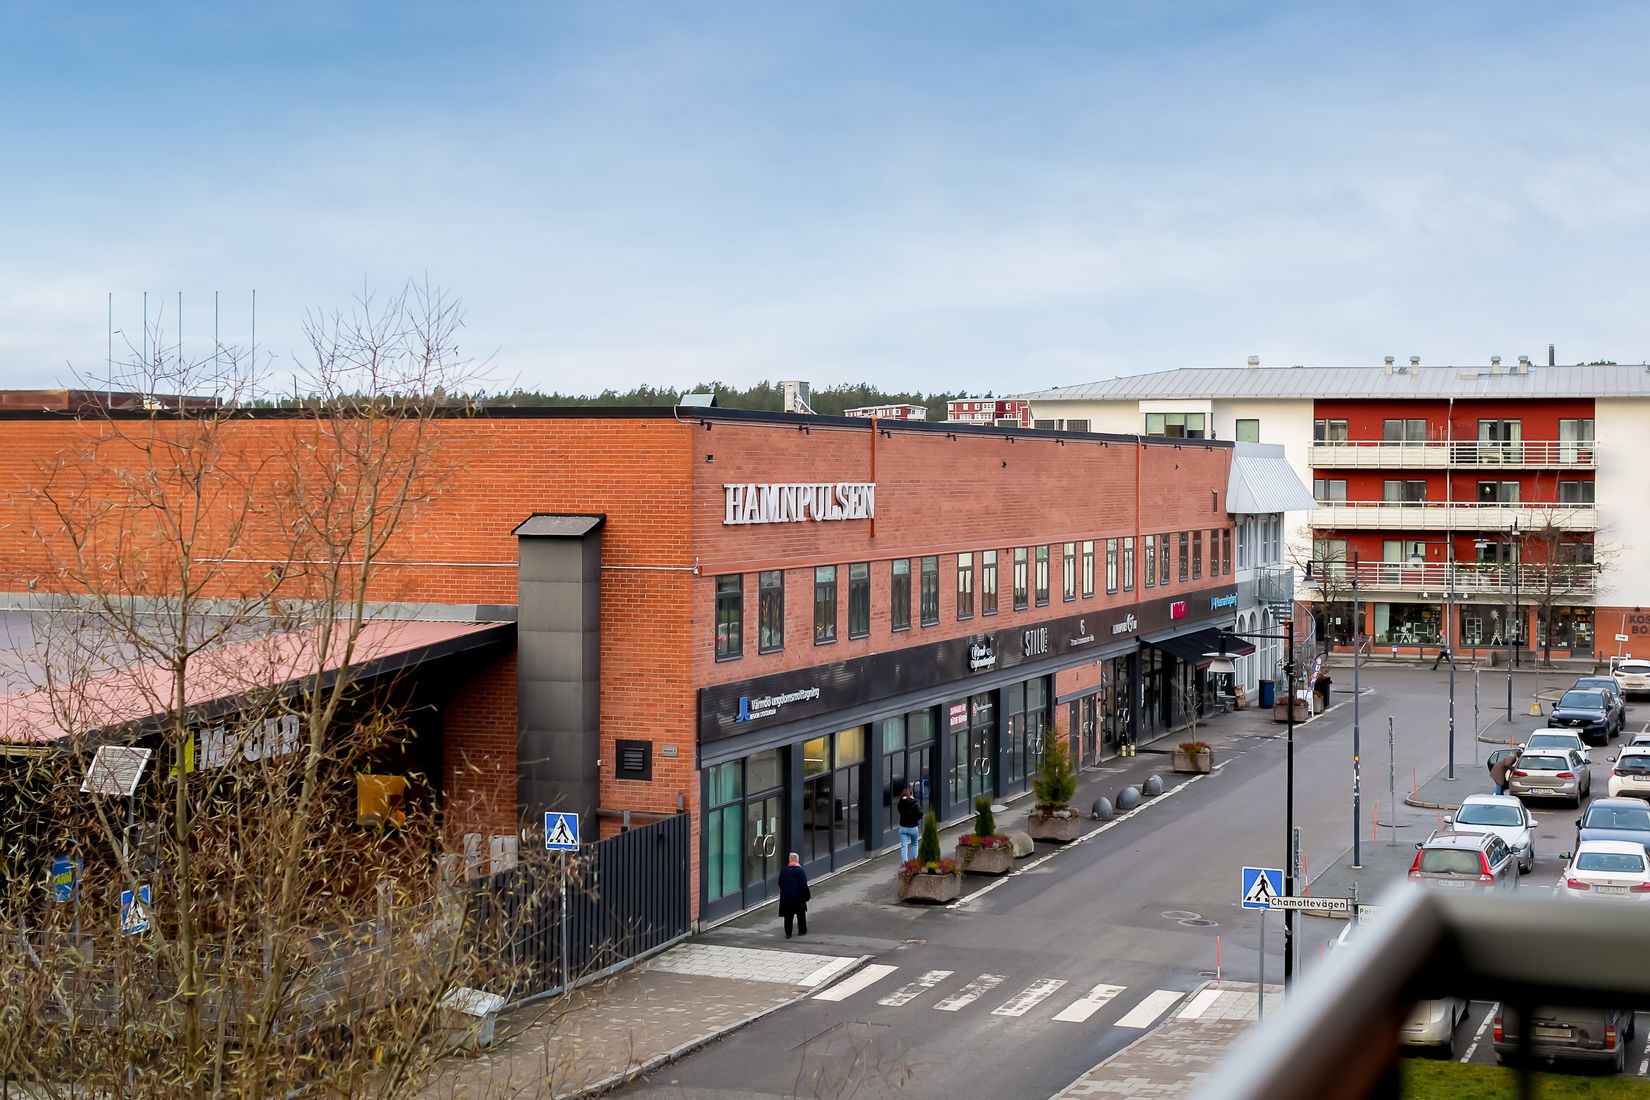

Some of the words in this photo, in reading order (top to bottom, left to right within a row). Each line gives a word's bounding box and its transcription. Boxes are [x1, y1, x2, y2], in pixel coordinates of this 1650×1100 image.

[723, 482, 877, 525] HAMNPULSEN
[1025, 627, 1044, 656] STILO
[1271, 897, 1346, 910] Chamottevägen
